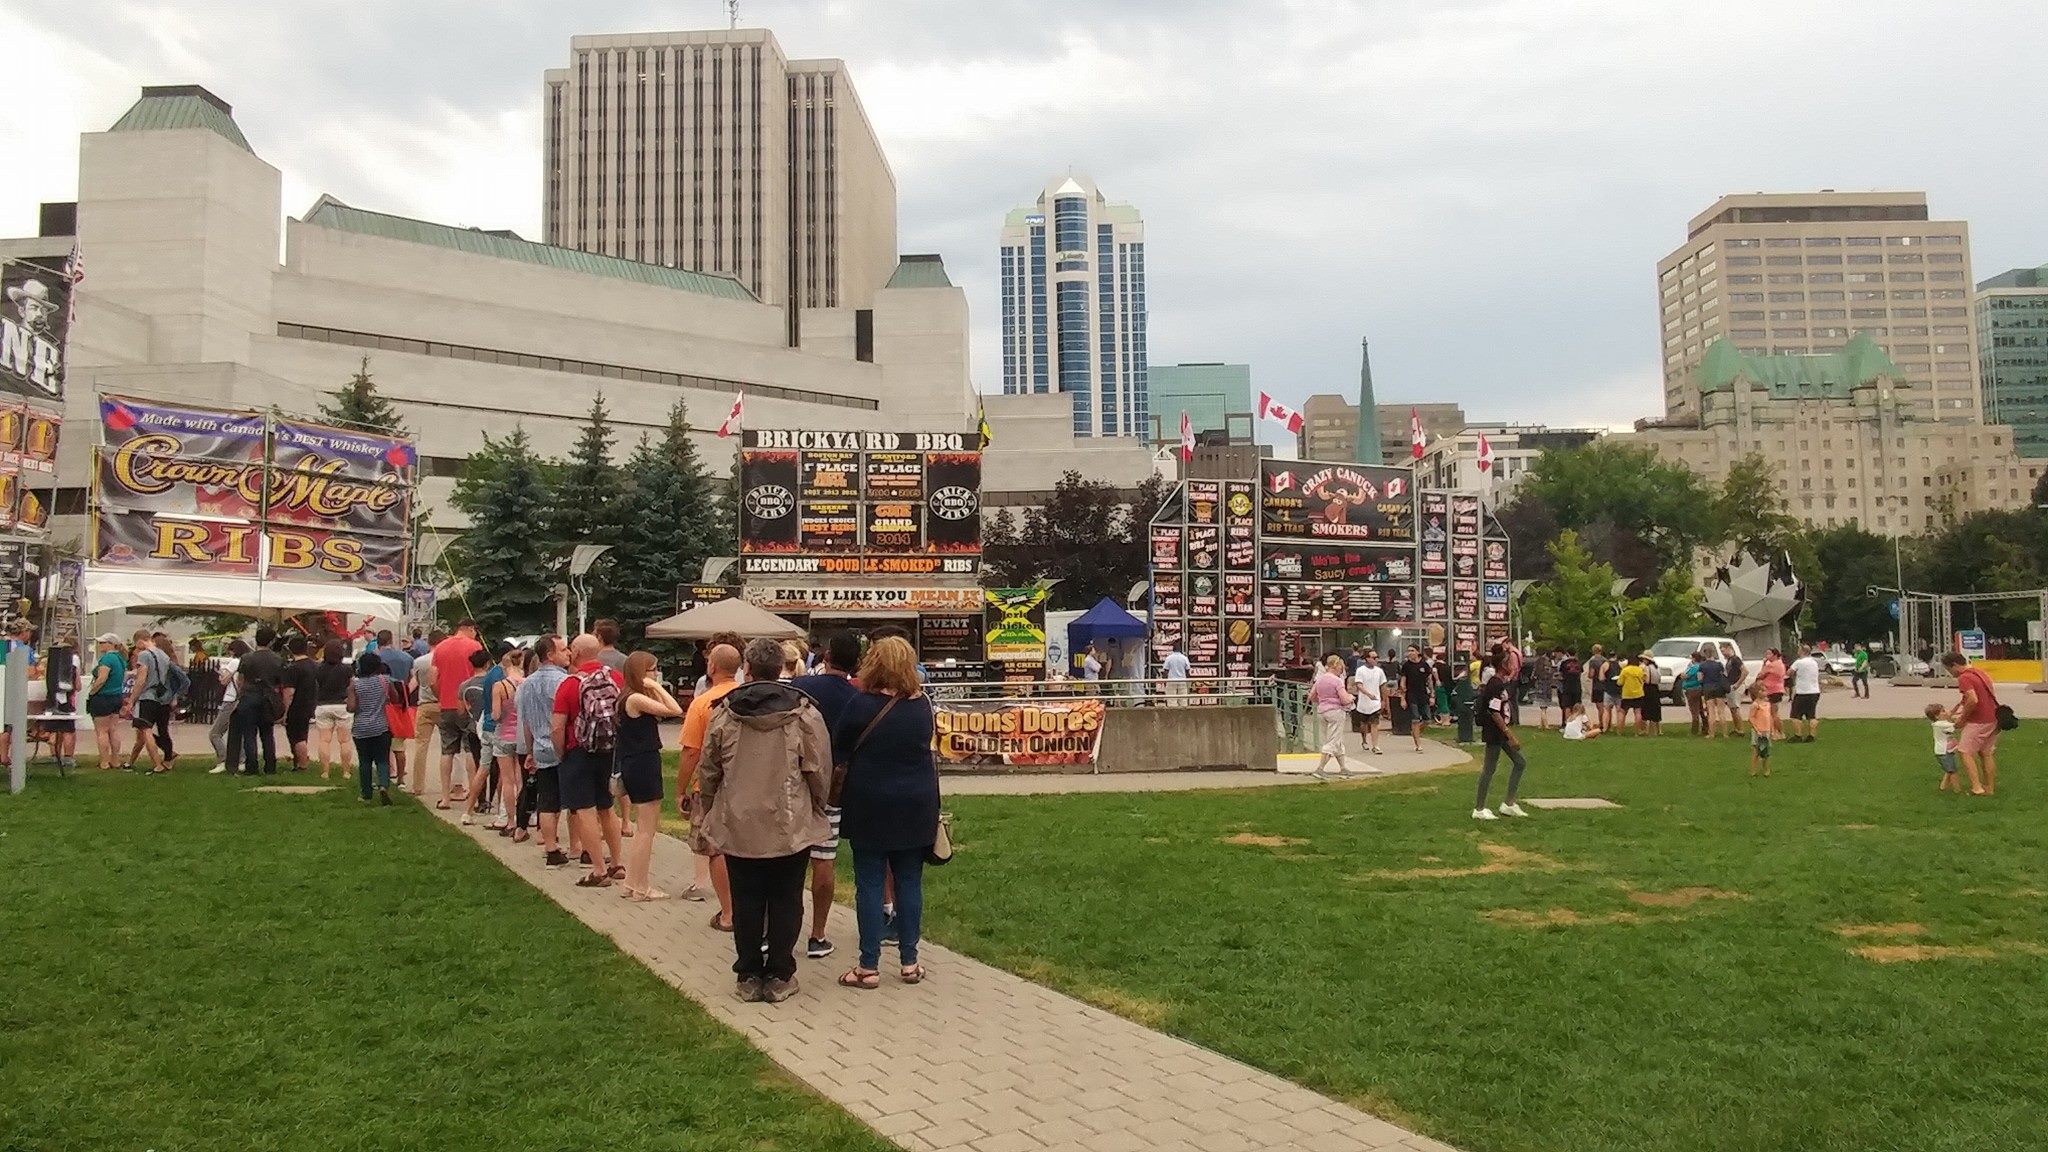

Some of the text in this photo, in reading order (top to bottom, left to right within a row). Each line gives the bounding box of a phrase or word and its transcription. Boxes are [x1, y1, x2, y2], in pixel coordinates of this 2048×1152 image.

[139, 413, 384, 457] Made with Canad's BEST Whiskey
[757, 430, 964, 451] BRICKYARD BBQ
[816, 463, 858, 472] PLACE
[880, 464, 921, 473] PLACE
[113, 434, 401, 518] Crown Maple
[1302, 467, 1379, 499] CRAZY CANUCK
[749, 485, 788, 500] BRICK
[935, 487, 971, 499] BRICK
[759, 497, 781, 506] BBQ
[943, 499, 964, 507] BBQ
[754, 506, 788, 519] YARD
[938, 507, 970, 519] YARD
[1196, 528, 1216, 539] PLACE
[1230, 528, 1250, 537] RIBS
[1311, 523, 1368, 537] SMOKERS
[151, 520, 365, 574] RIBS
[746, 559, 820, 572] LEGENDARY
[943, 560, 973, 572] RIBS
[1315, 569, 1346, 580] Saucy
[775, 590, 807, 600] EAT
[811, 590, 829, 600] IT
[833, 591, 873, 600] LIKE
[875, 591, 907, 600] YOU
[911, 591, 959, 601] MEAN
[923, 619, 970, 629] EVENT
